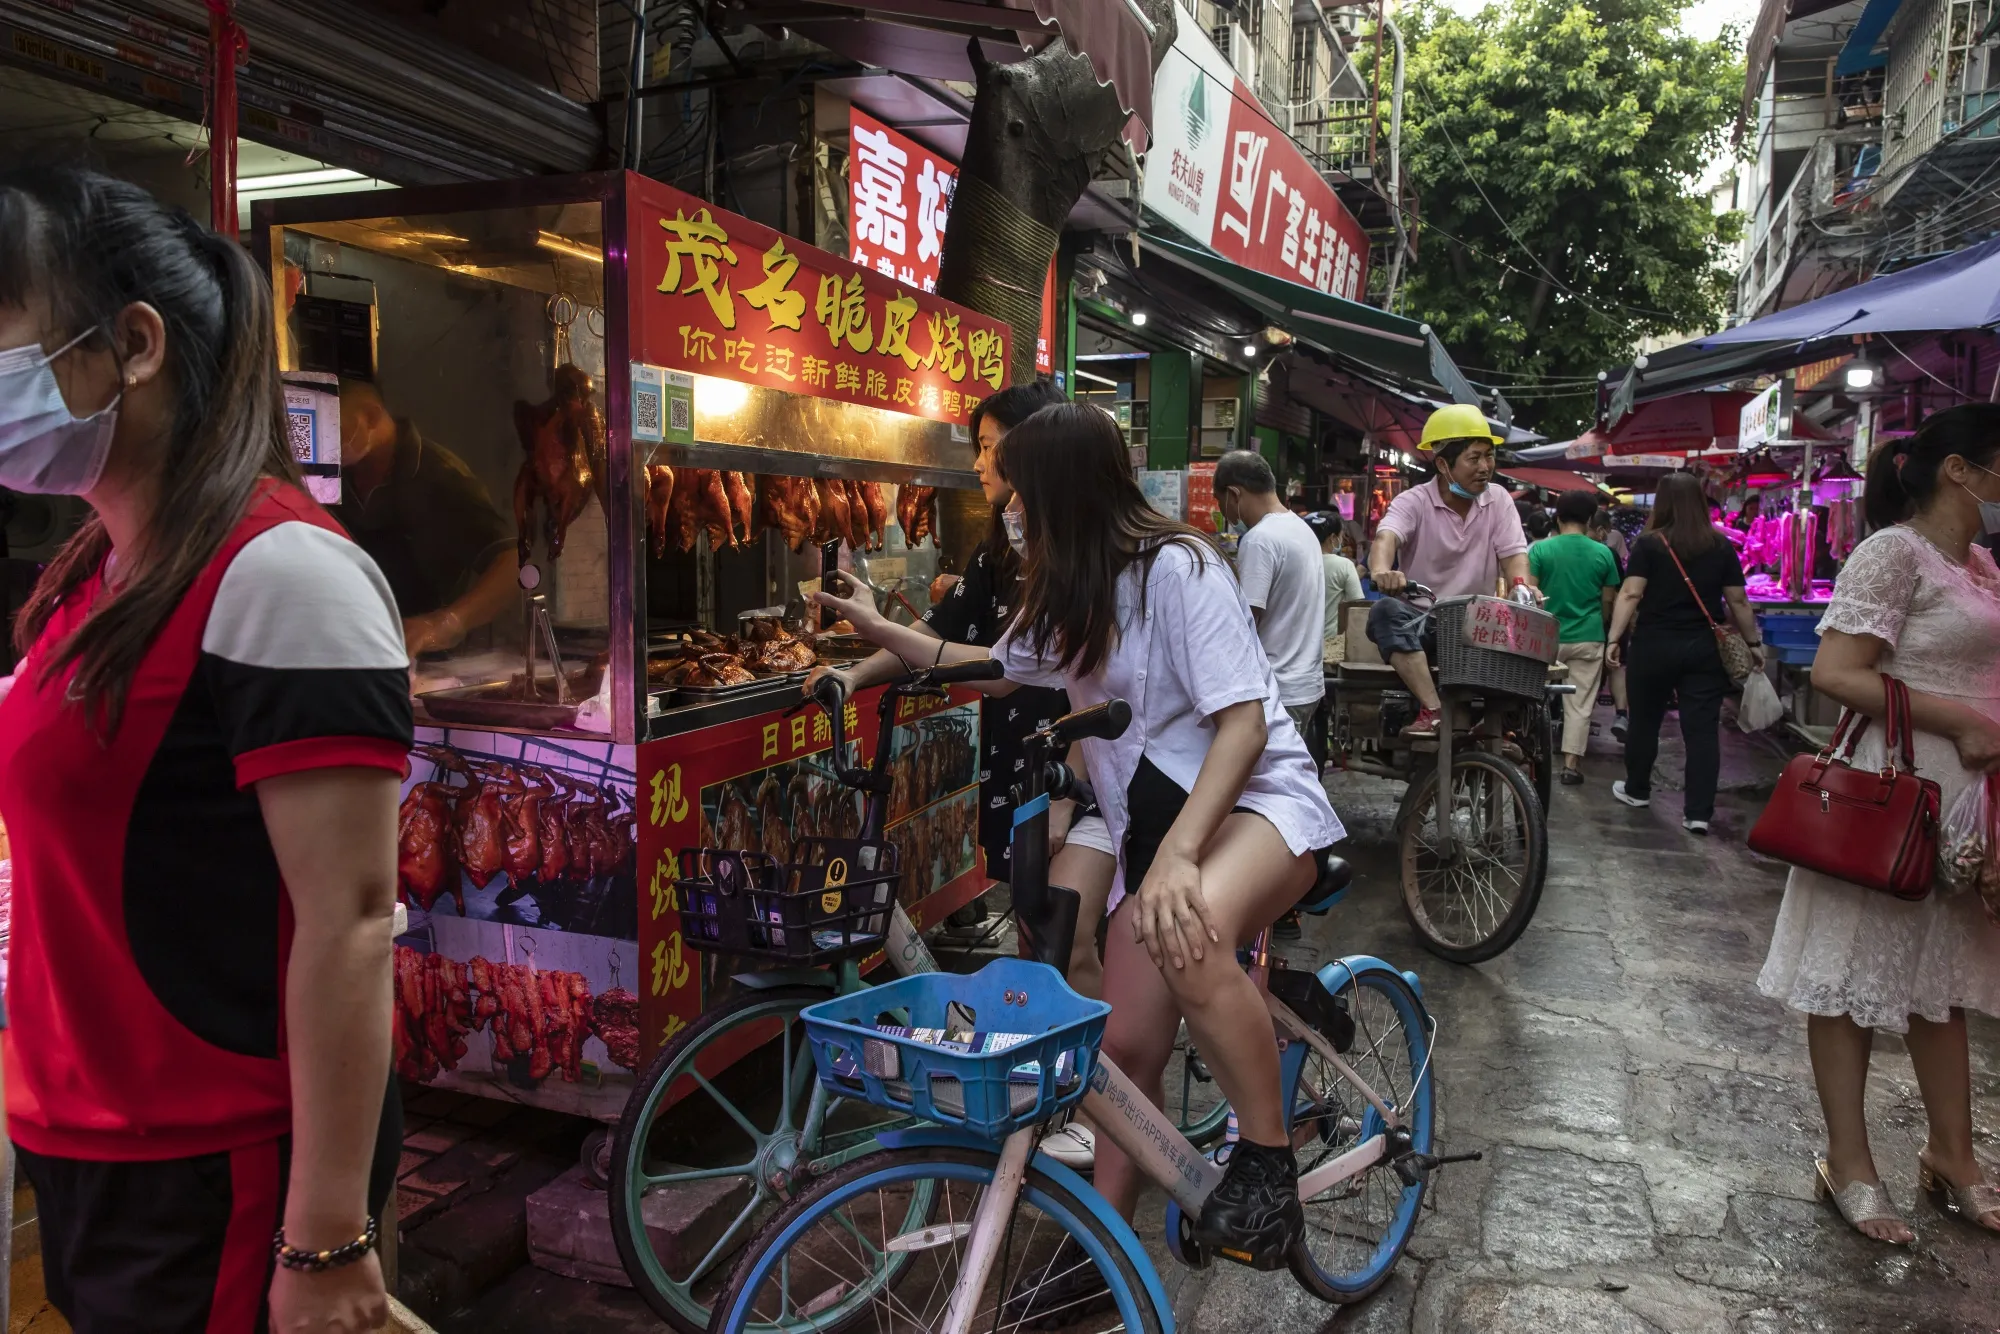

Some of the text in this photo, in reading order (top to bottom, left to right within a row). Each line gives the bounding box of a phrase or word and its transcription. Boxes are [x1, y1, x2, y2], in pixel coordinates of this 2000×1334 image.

[1171, 148, 1205, 197] 农夫山泉
[1184, 194, 1200, 216] SPRING
[656, 207, 1005, 391] 茂名脆皮烧鸭
